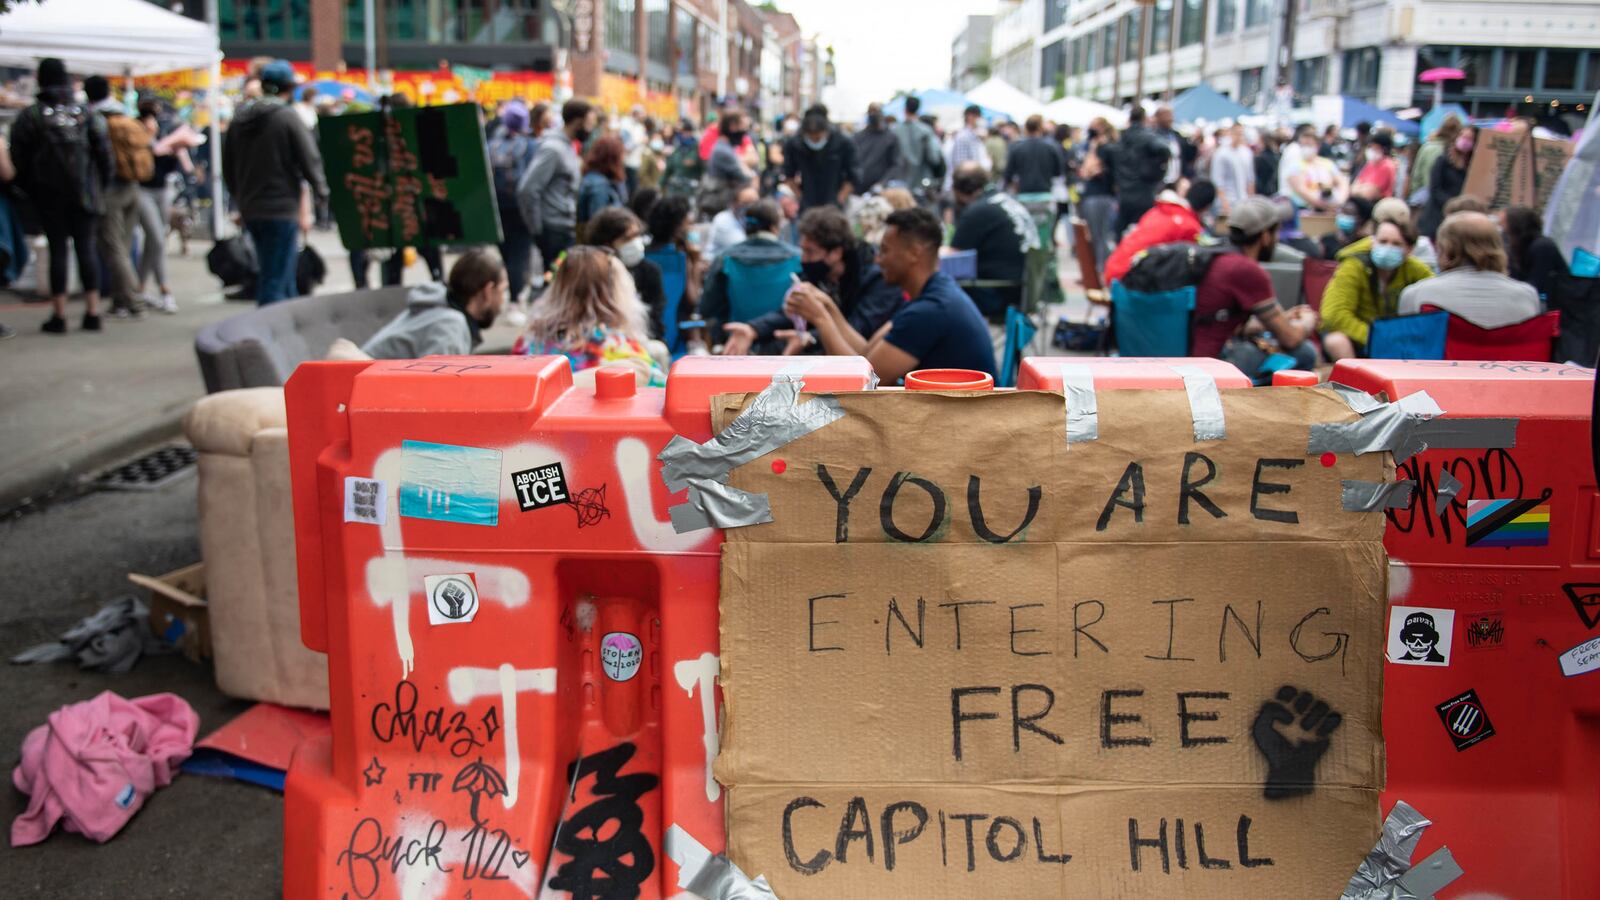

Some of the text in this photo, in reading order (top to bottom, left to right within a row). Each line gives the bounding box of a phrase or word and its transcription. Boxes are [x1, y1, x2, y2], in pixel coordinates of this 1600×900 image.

[516, 466, 560, 486] ABOLISH
[518, 477, 566, 508] ICE
[816, 463, 1042, 543] YOU
[1096, 452, 1305, 531] ARE
[602, 648, 640, 658] STOLEN
[808, 592, 1350, 675] ENTERING
[951, 684, 1231, 761] FREE
[408, 772, 443, 793] FTP
[781, 796, 1274, 876] CAPITOL HILL
